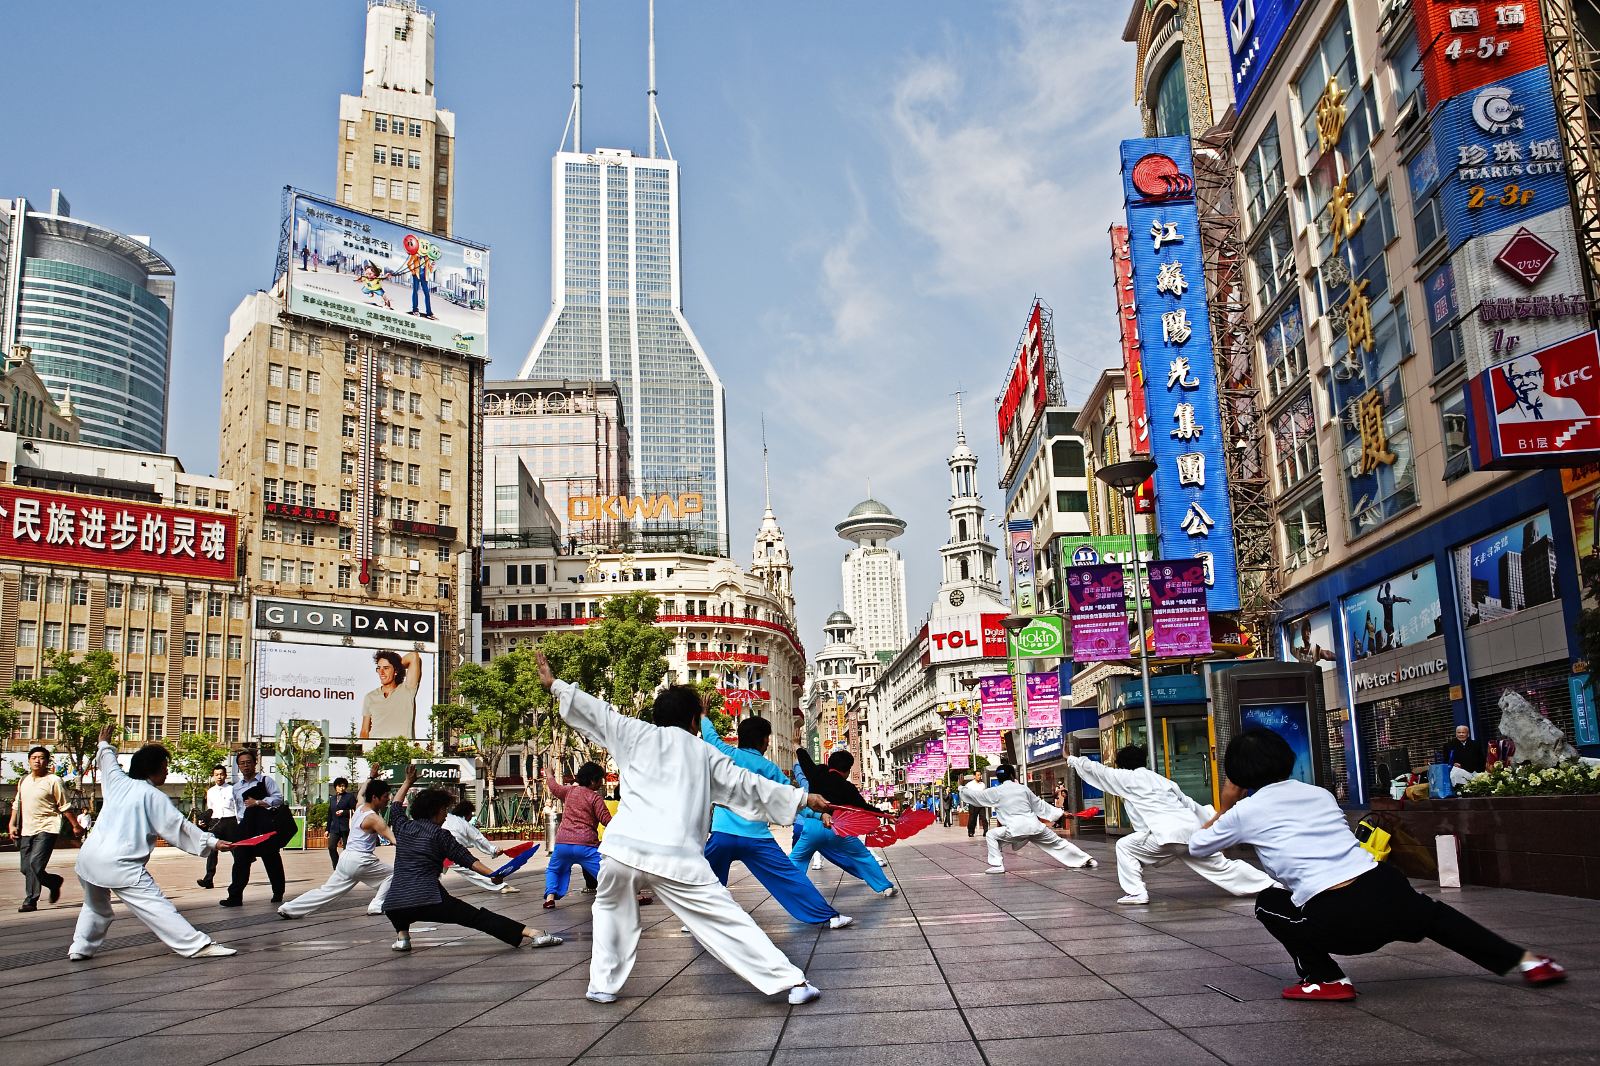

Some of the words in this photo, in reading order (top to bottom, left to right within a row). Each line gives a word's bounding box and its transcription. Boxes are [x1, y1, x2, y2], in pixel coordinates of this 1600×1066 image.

[1458, 139, 1560, 165] 珍珠城
[1460, 164, 1523, 181] PEARLS
[1526, 161, 1562, 175] CITY
[1467, 183, 1536, 209] 2-3F
[1553, 365, 1593, 391] KFC
[1518, 437, 1549, 450] B1层
[568, 492, 702, 521] OKWAP
[266, 606, 429, 634] GIORDANO
[932, 630, 978, 650] TCL
[260, 685, 321, 699] giordano
[323, 688, 355, 700] linen
[421, 768, 447, 778] Chez
